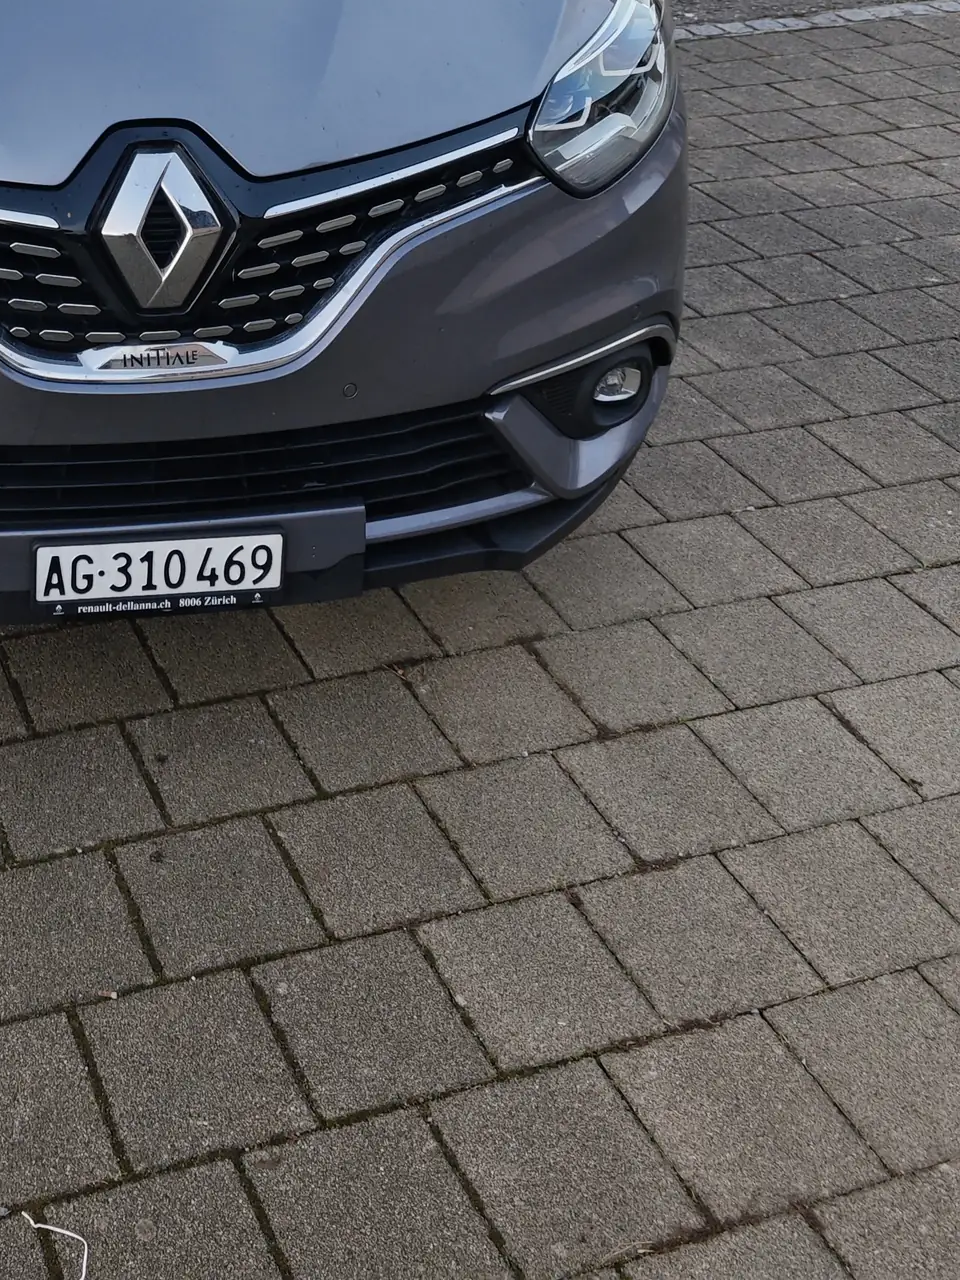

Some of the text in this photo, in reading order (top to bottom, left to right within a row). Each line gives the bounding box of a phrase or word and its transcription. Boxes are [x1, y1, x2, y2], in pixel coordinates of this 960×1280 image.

[123, 347, 198, 368] INITIALE
[77, 595, 237, 614] renault-dellanna.ch 8006 Zürich
